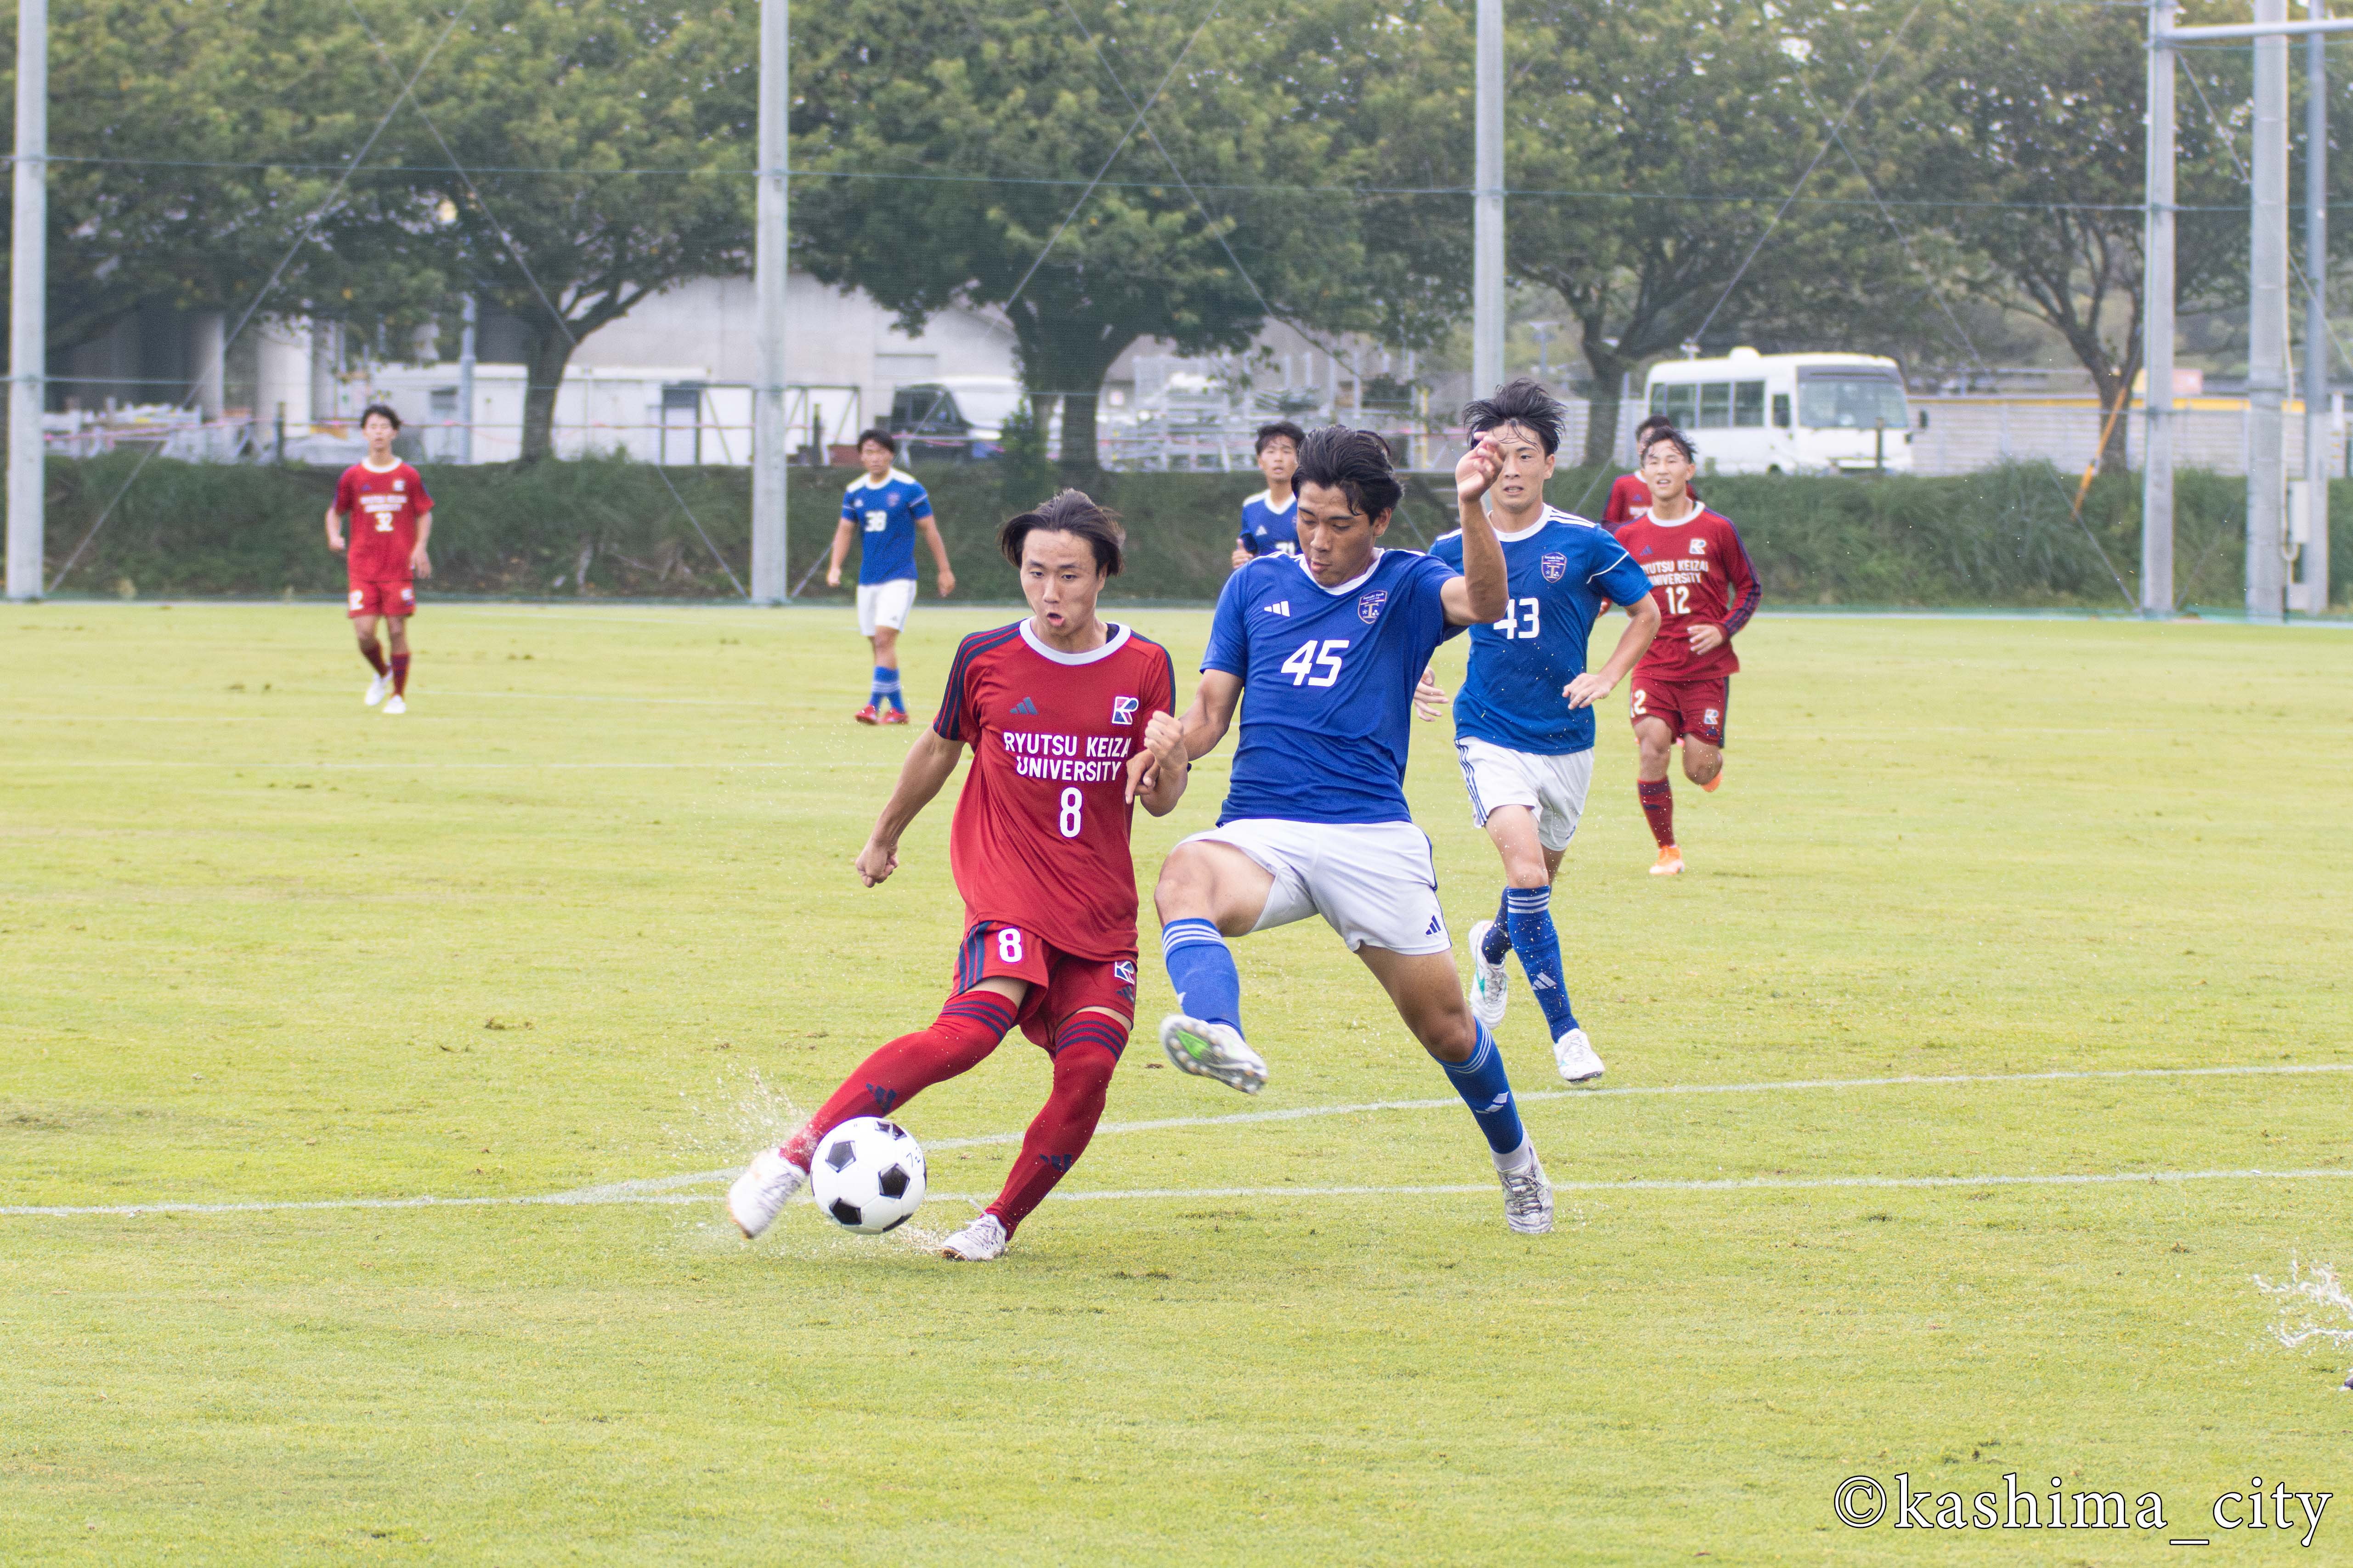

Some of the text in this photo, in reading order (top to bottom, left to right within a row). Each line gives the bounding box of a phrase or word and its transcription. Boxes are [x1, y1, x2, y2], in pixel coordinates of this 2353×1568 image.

[376, 513, 393, 531] 32
[865, 510, 887, 531] 38
[1640, 559, 1709, 575] YUTSU KEIZAI
[1665, 586, 1691, 615] 12
[1493, 598, 1539, 640] 43
[1281, 640, 1350, 687] 45
[1003, 732, 1078, 756] RYUTSU
[1017, 756, 1122, 782] UNIVERSITY
[1060, 787, 1082, 838] 8
[998, 928, 1023, 963] 8
